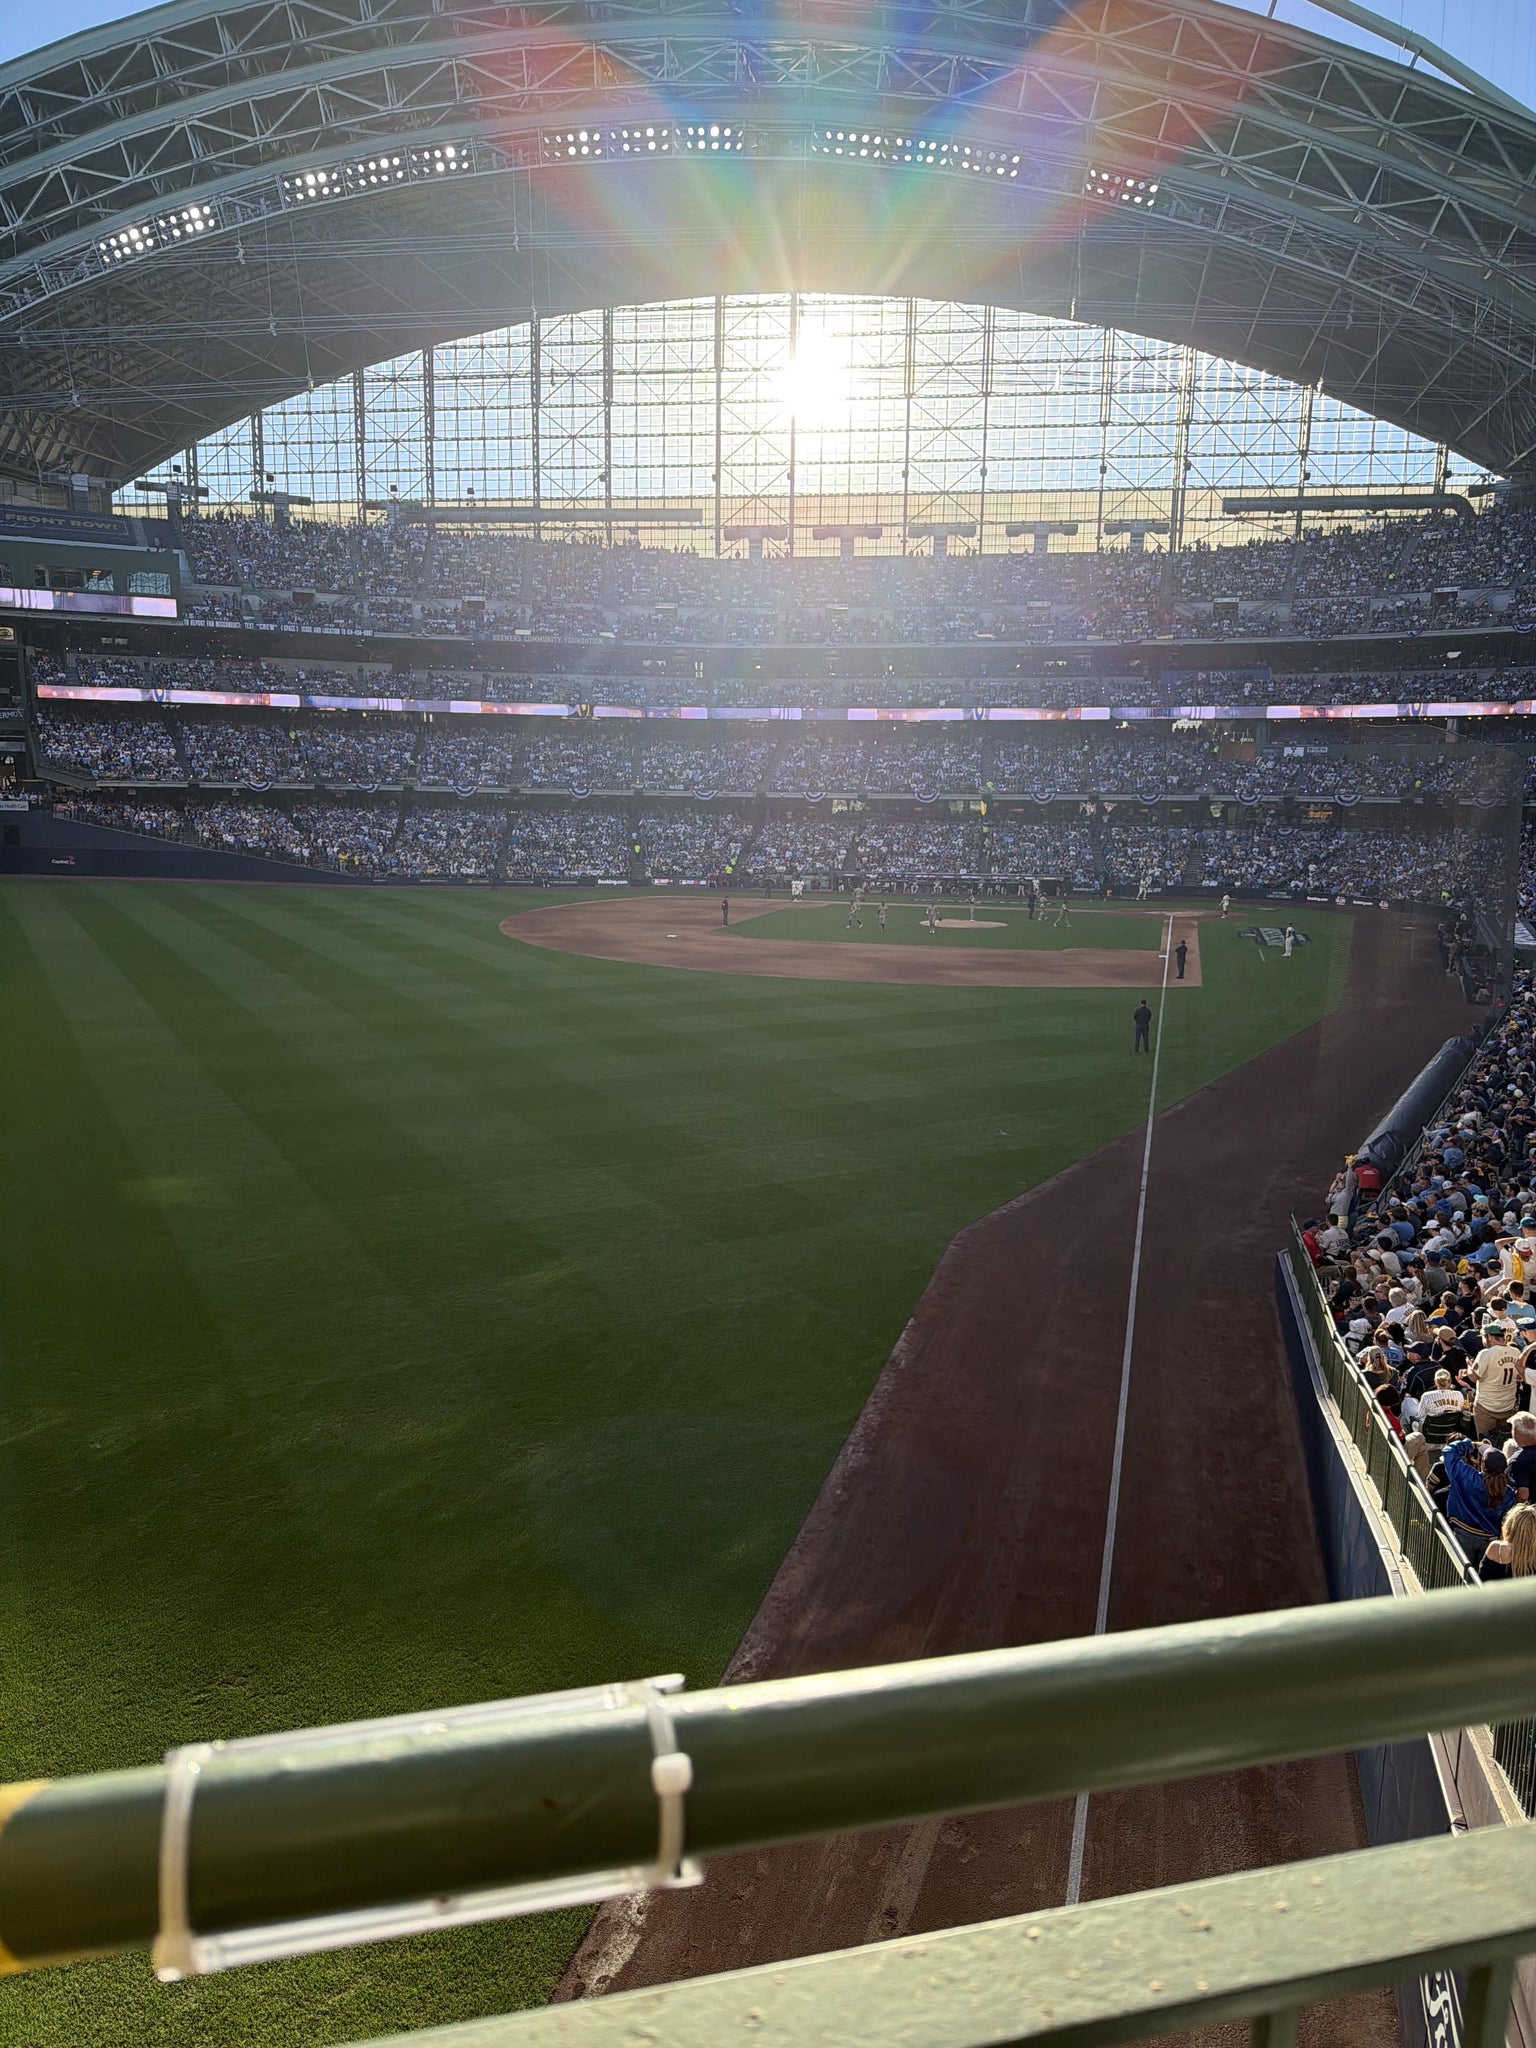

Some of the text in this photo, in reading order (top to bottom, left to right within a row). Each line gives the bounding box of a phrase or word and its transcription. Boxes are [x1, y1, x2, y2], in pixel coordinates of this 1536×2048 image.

[5, 513, 65, 527] FRONT
[190, 619, 205, 627] REPORT
[206, 620, 215, 628] FAN
[244, 622, 254, 630] TEXT
[492, 634, 603, 645] BREWERS COMMUNITY FOUNDATION
[1502, 1367, 1514, 1385] 11
[1433, 1398, 1459, 1408] TURANG
